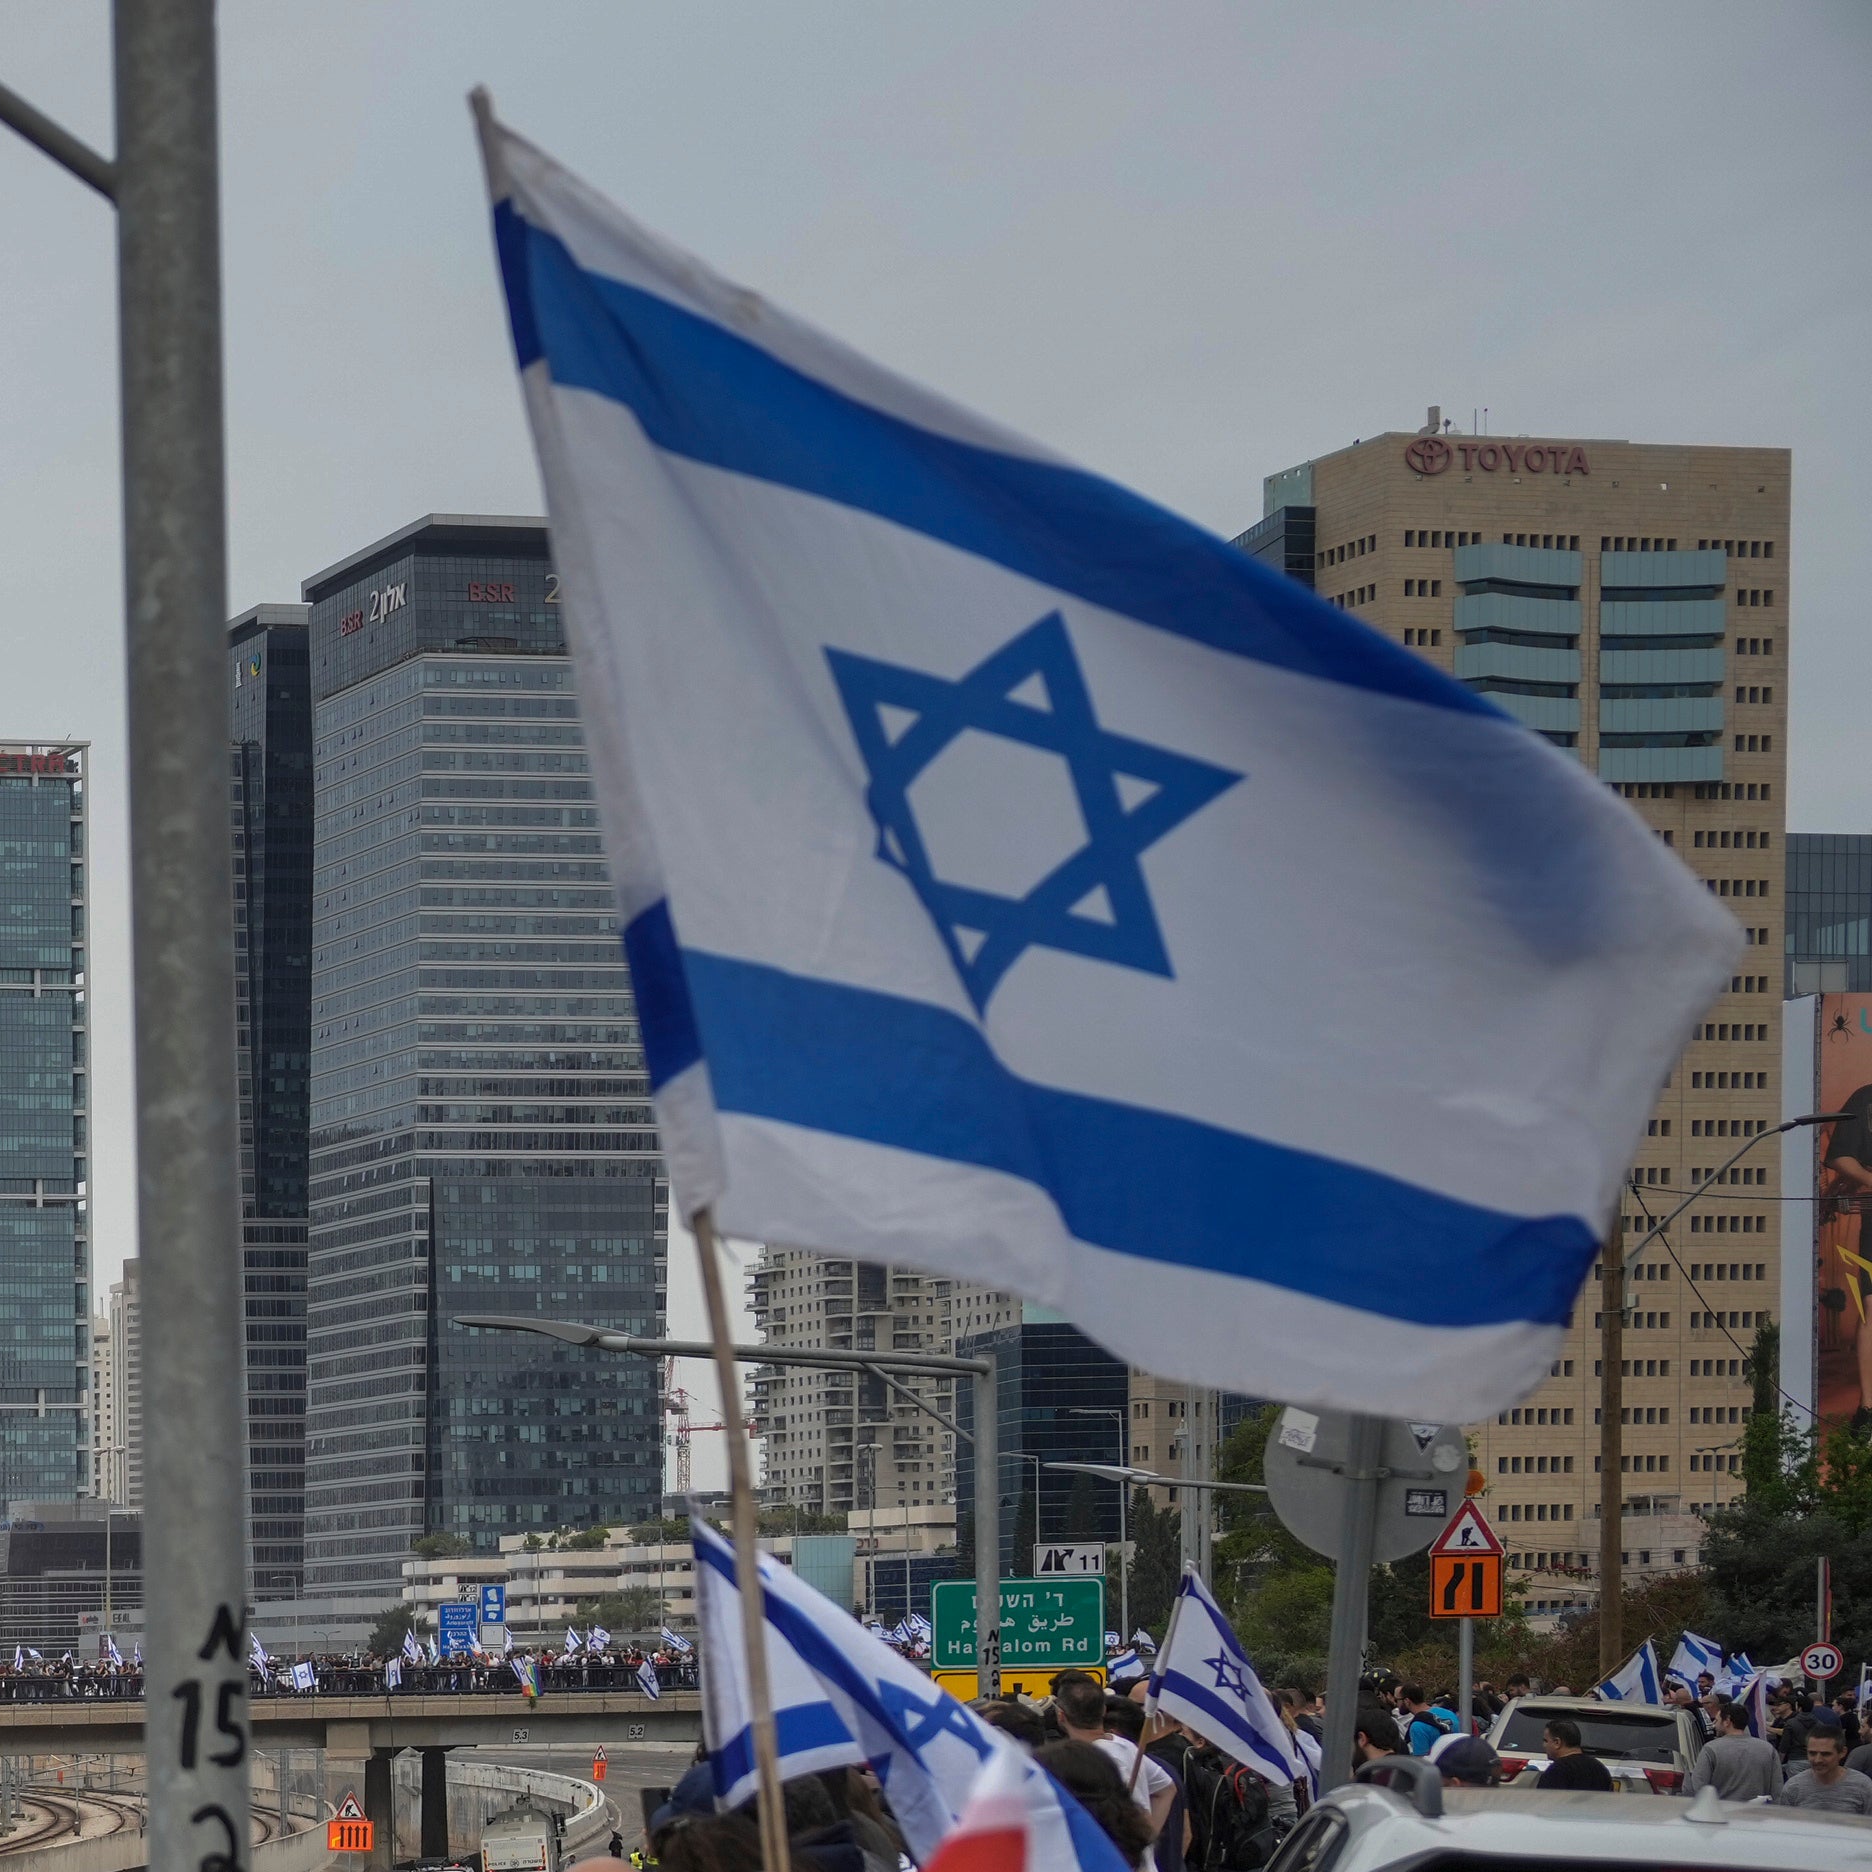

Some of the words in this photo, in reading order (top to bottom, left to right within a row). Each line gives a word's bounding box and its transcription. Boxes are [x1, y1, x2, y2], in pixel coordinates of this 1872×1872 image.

[1458, 444, 1591, 475] TOYOTA
[1079, 1554, 1099, 1571] 11
[948, 1639, 1051, 1655] Haalom
[1062, 1638, 1088, 1652] Rd
[1807, 1653, 1835, 1669] 30
[170, 1678, 246, 1769] 15
[629, 1727, 643, 1736] 5.2
[514, 1731, 528, 1740] 5.3
